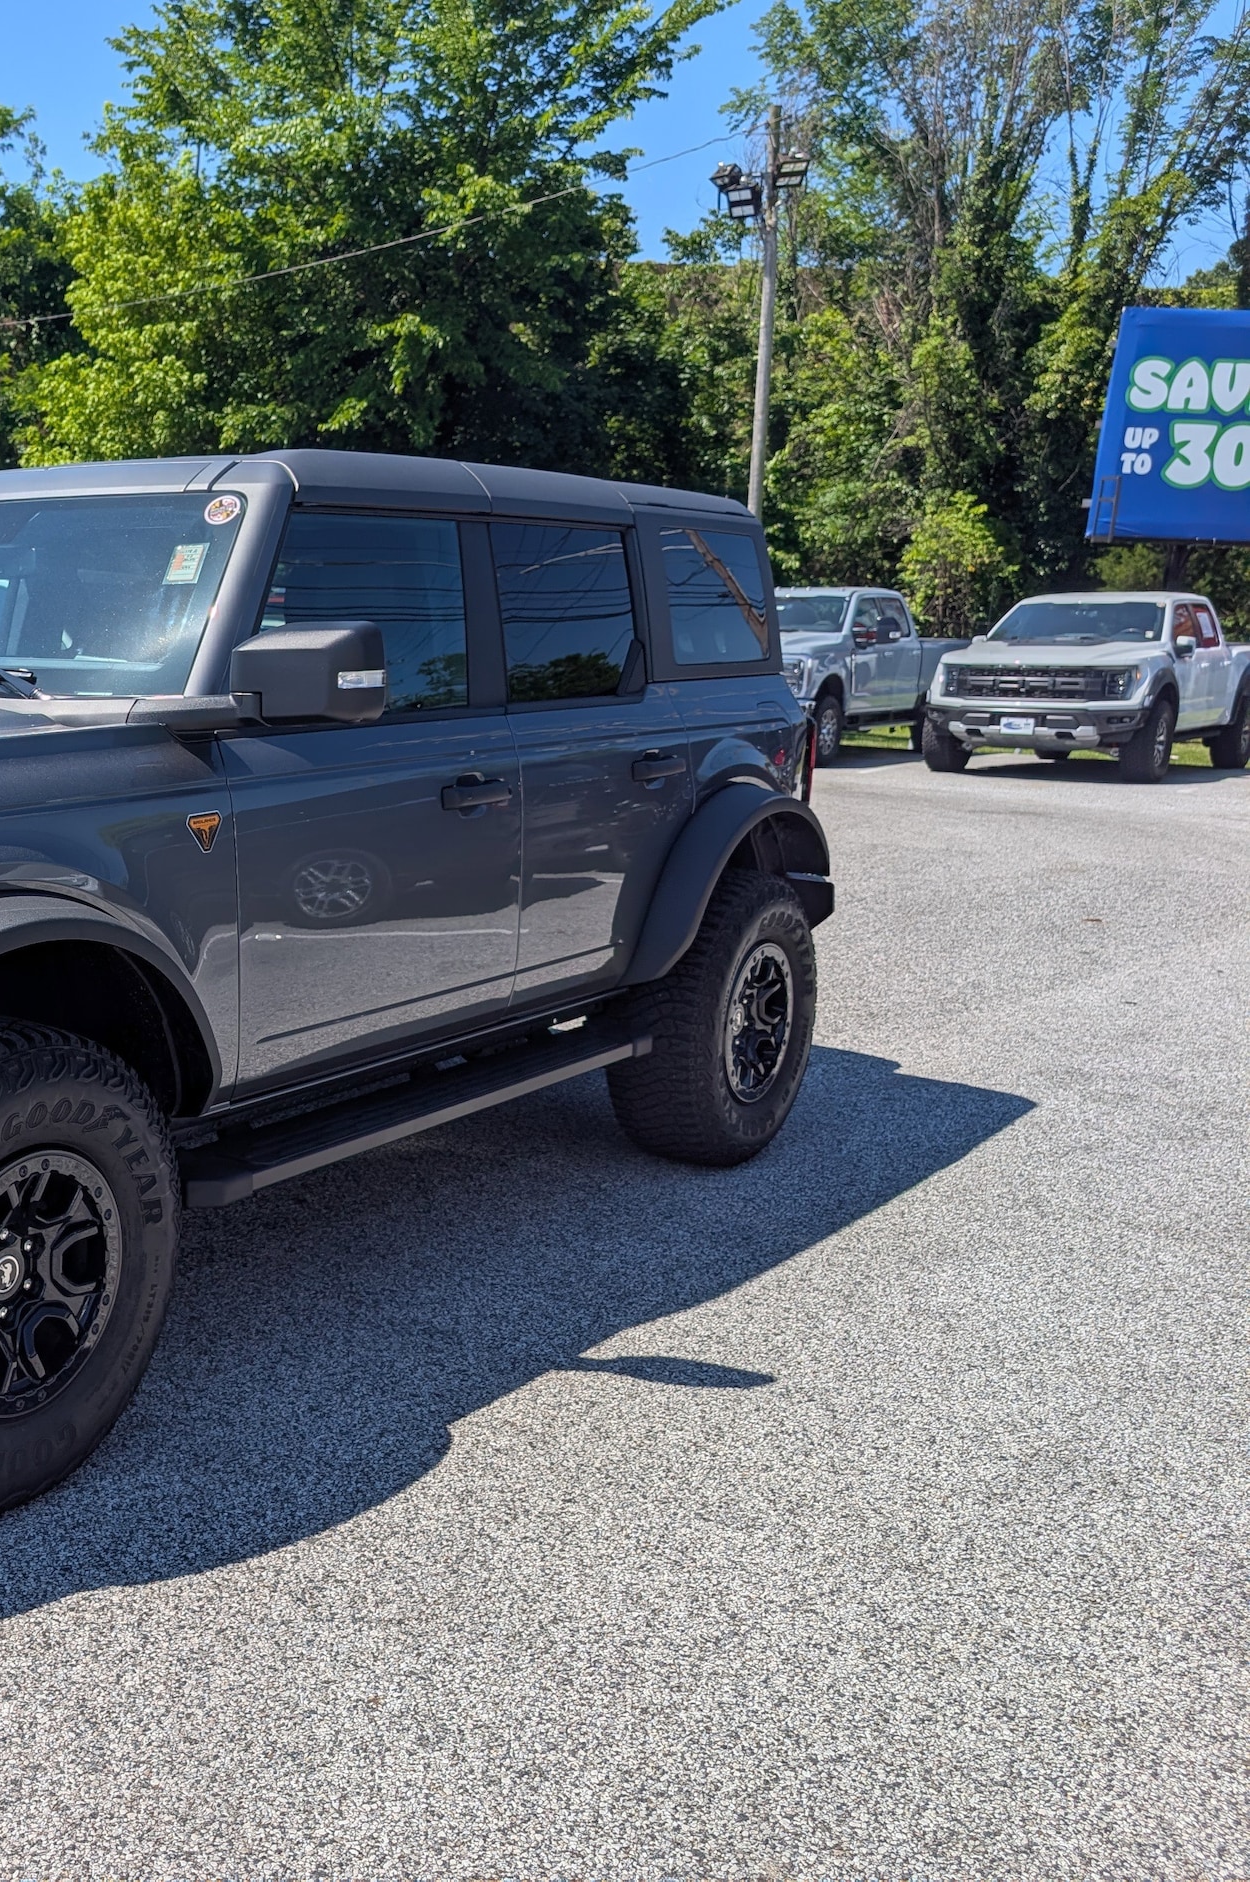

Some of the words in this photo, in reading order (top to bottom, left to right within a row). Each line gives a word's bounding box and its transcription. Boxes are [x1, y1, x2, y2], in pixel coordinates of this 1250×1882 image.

[1127, 357, 1250, 414] SAV
[1121, 453, 1152, 475] TO
[1124, 427, 1159, 449] UP
[1163, 421, 1250, 488] 30
[1, 1098, 163, 1225] GOODYEAR
